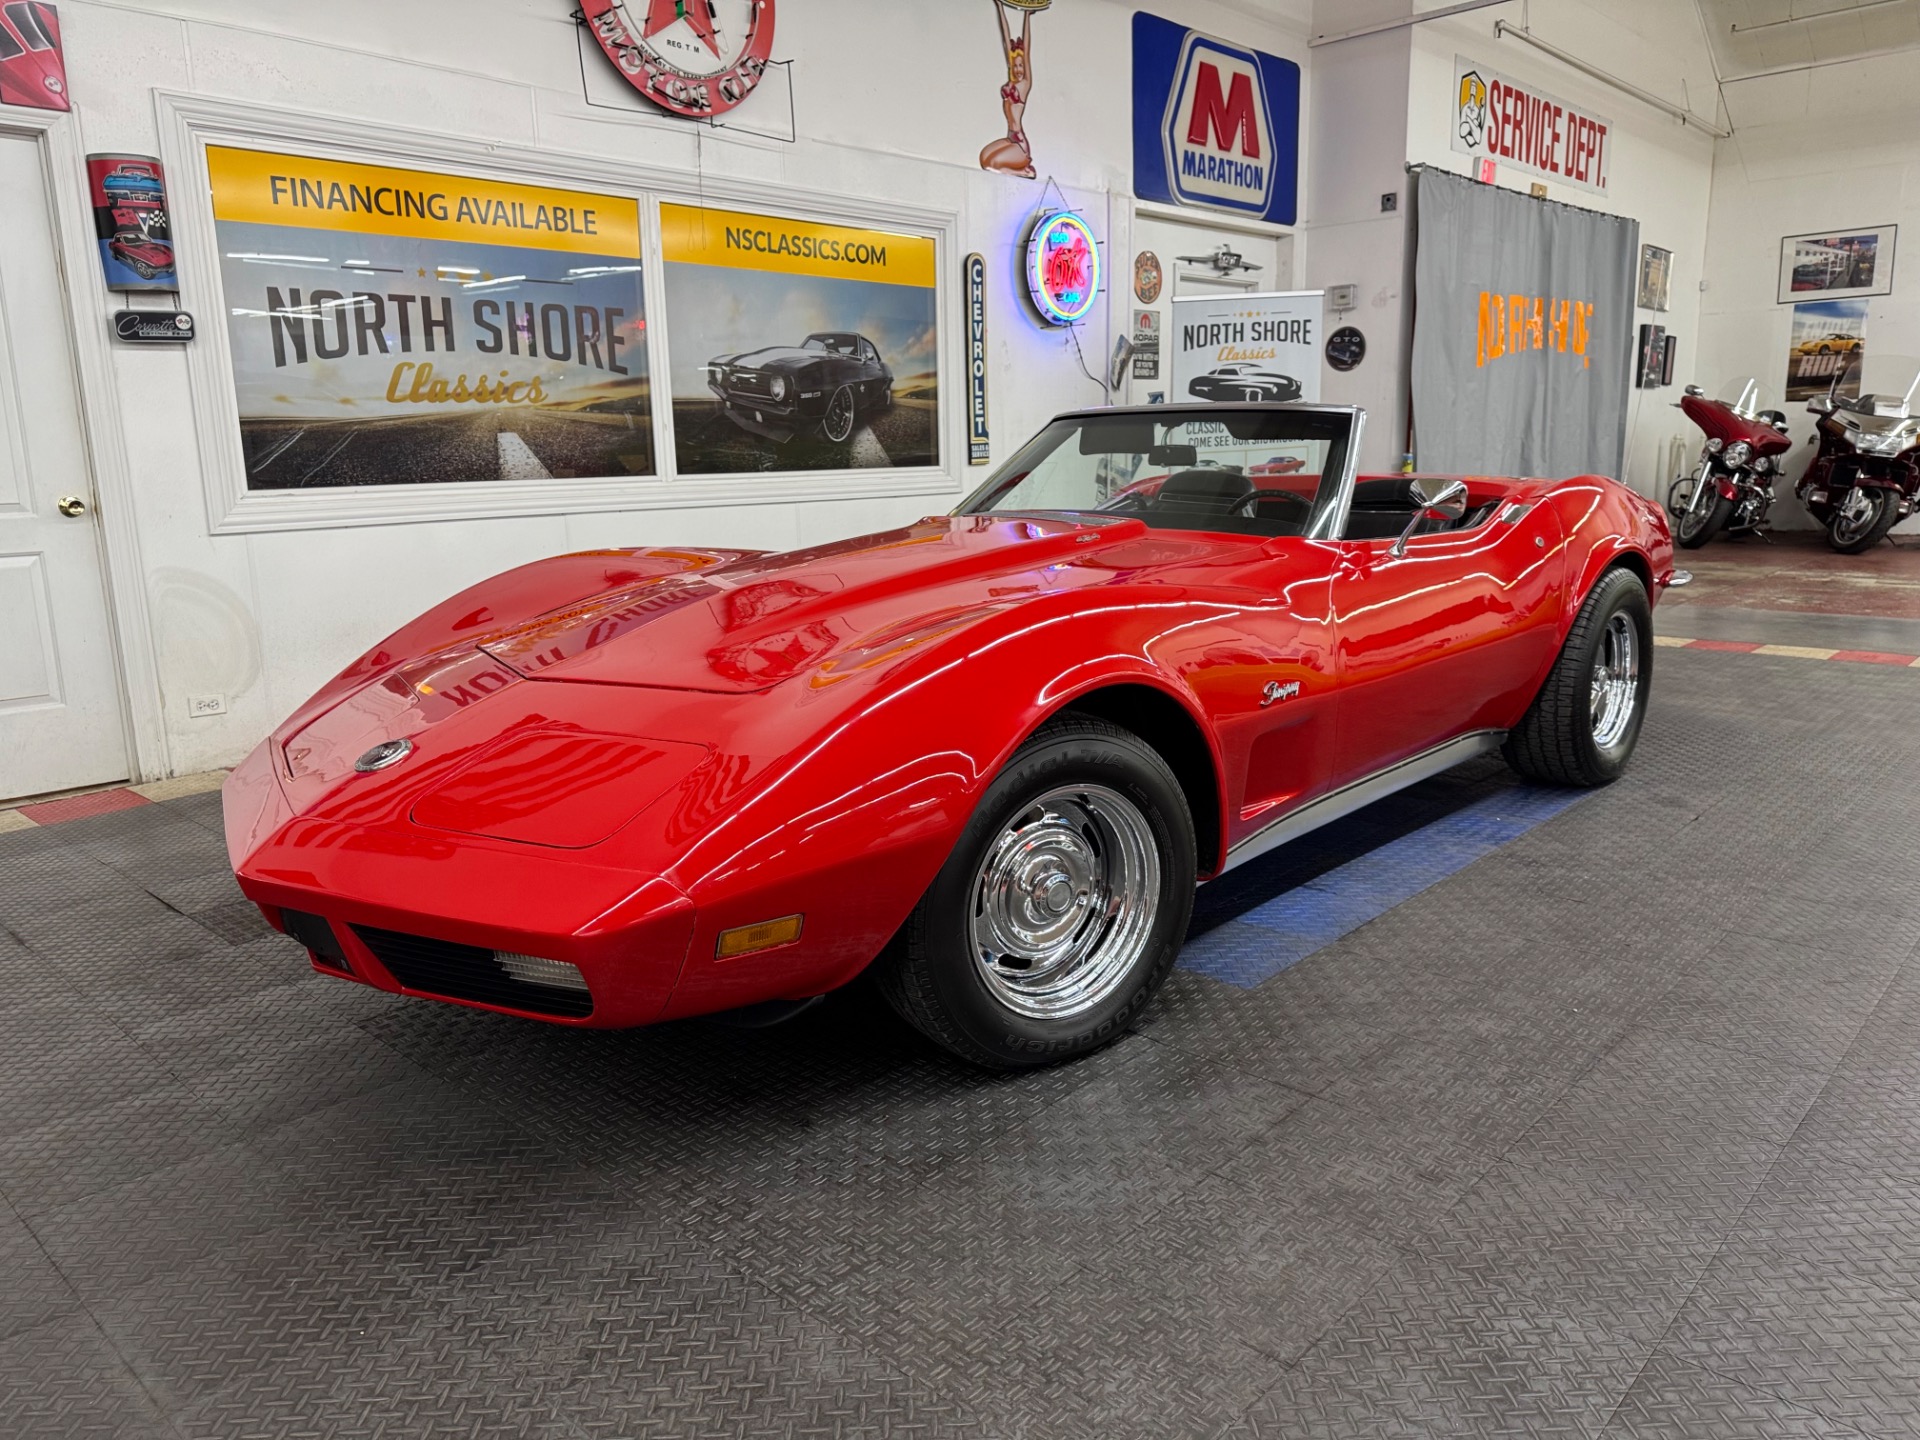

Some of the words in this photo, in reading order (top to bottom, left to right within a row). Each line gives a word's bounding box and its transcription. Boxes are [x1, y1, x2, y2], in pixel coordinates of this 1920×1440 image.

[1187, 61, 1260, 159] M
[1487, 79, 1563, 174] SERVICE
[1564, 111, 1608, 189] DEPT.
[1182, 149, 1264, 191] MARATHON
[269, 174, 448, 222] FINANCING
[455, 195, 599, 236] AVAILABLE
[725, 225, 887, 267] NSCLASSICS.COM
[266, 286, 457, 369] NORTH
[472, 299, 629, 376] SHORE
[971, 264, 985, 434] CHEVROLET
[1183, 322, 1245, 352] NORTH
[1251, 319, 1312, 346] SHORE
[1216, 346, 1278, 362] Classics
[1797, 355, 1846, 377] RIDE
[385, 361, 549, 404] Classics
[1186, 421, 1225, 435] CLASSIC
[1188, 435, 1213, 448] COME
[1214, 435, 1230, 447] SEE
